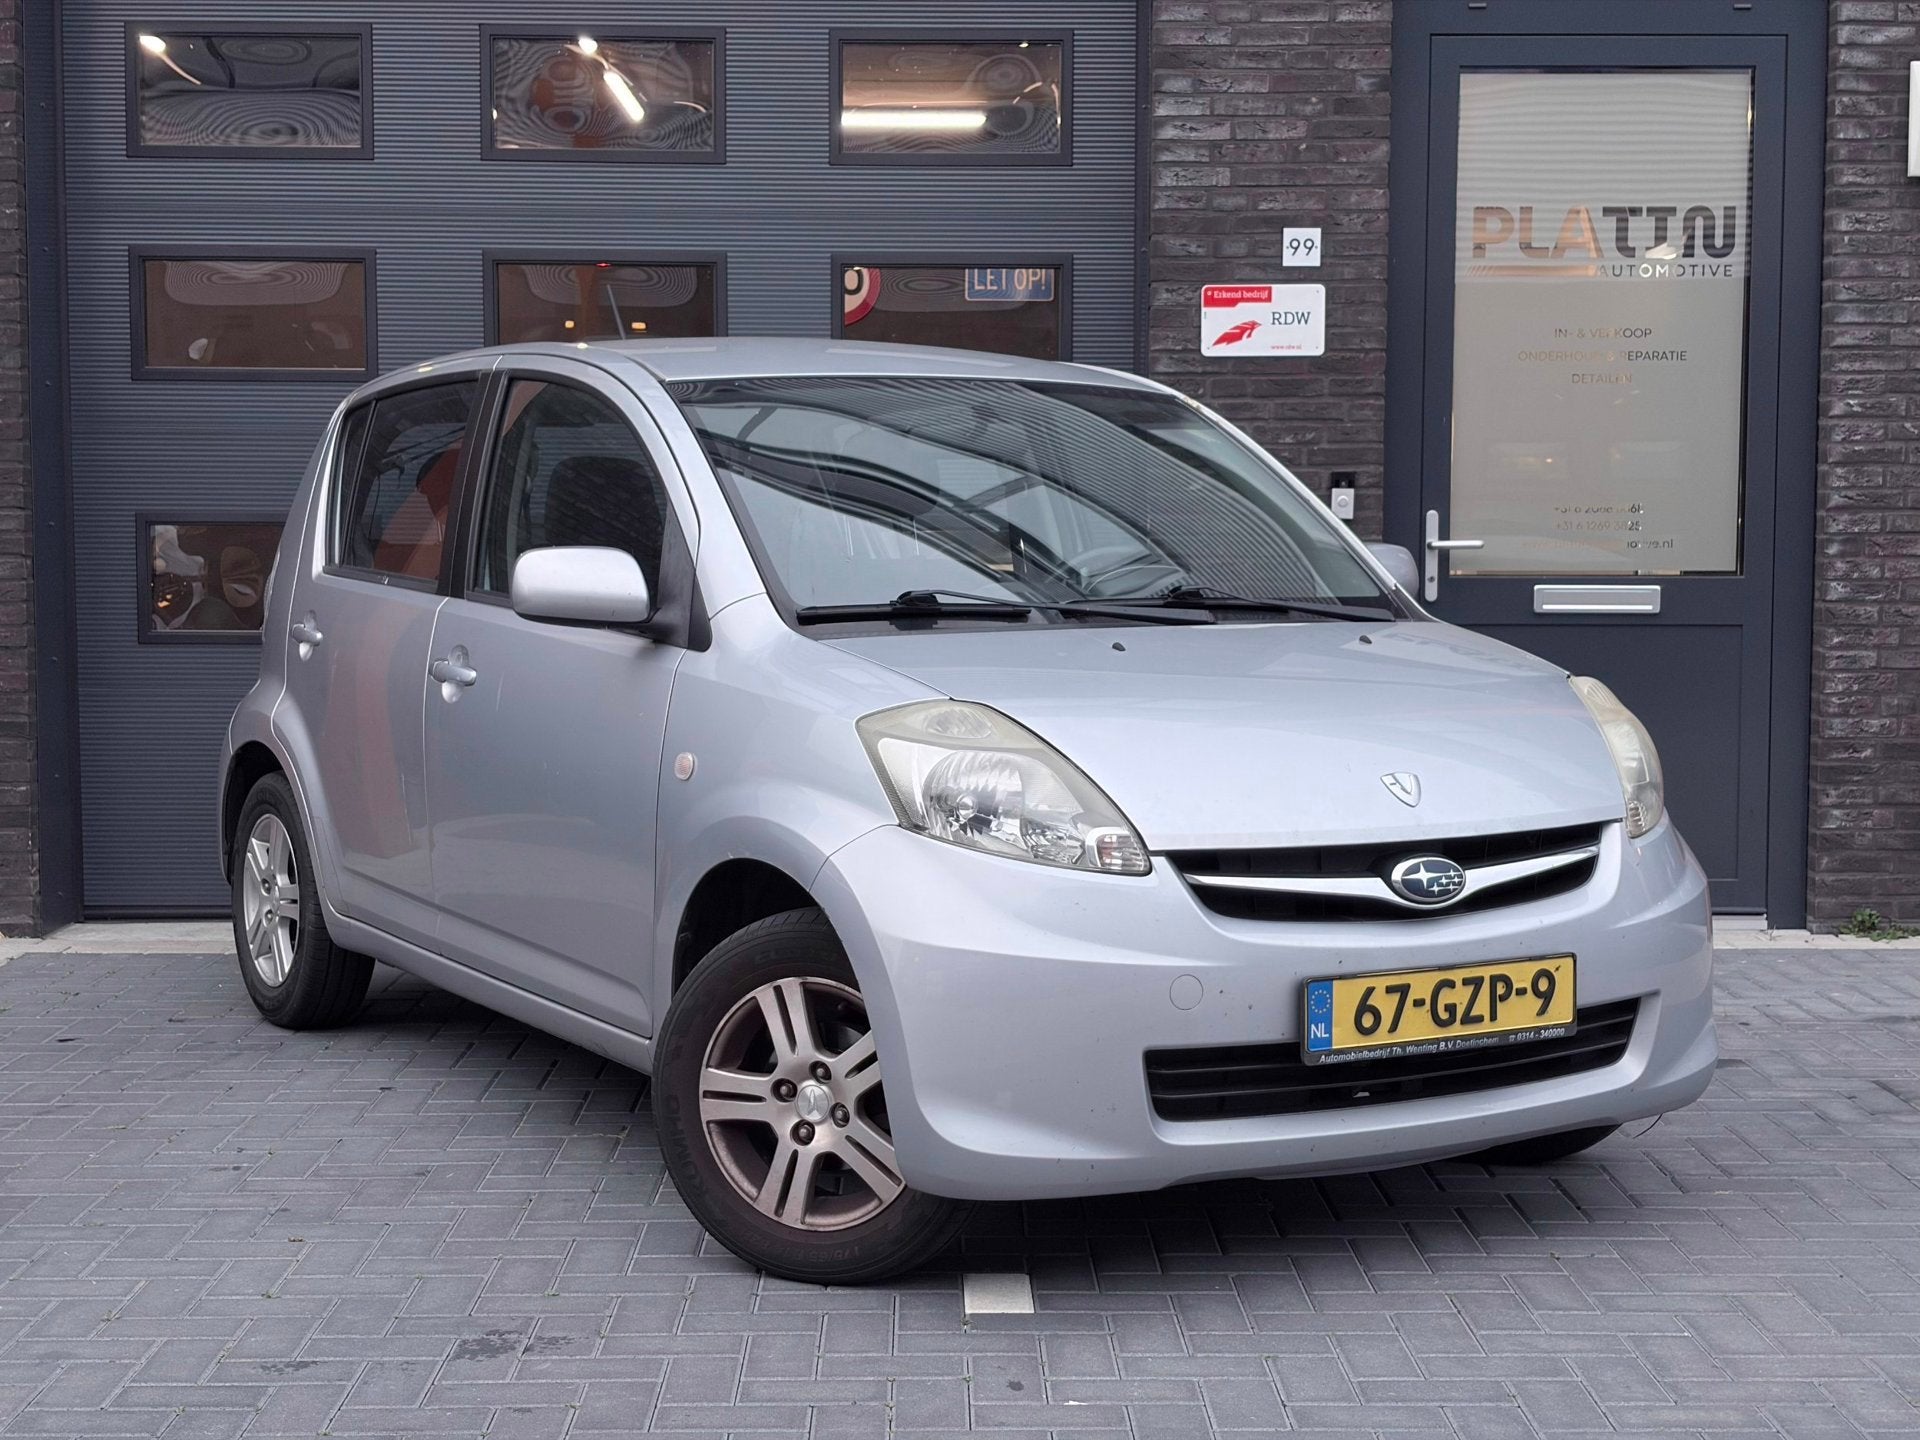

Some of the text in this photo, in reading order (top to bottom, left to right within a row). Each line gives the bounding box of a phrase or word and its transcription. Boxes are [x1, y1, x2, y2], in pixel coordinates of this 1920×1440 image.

[1289, 238, 1315, 256] 99
[1599, 263, 1733, 279] AUTOMOTIVE
[1213, 290, 1269, 300] Erkend bedrijf
[1271, 311, 1311, 326] RDW
[1354, 968, 1557, 1037] 67-GZP-9
[1310, 1022, 1330, 1039] NL
[1516, 1031, 1534, 1041] 0314
